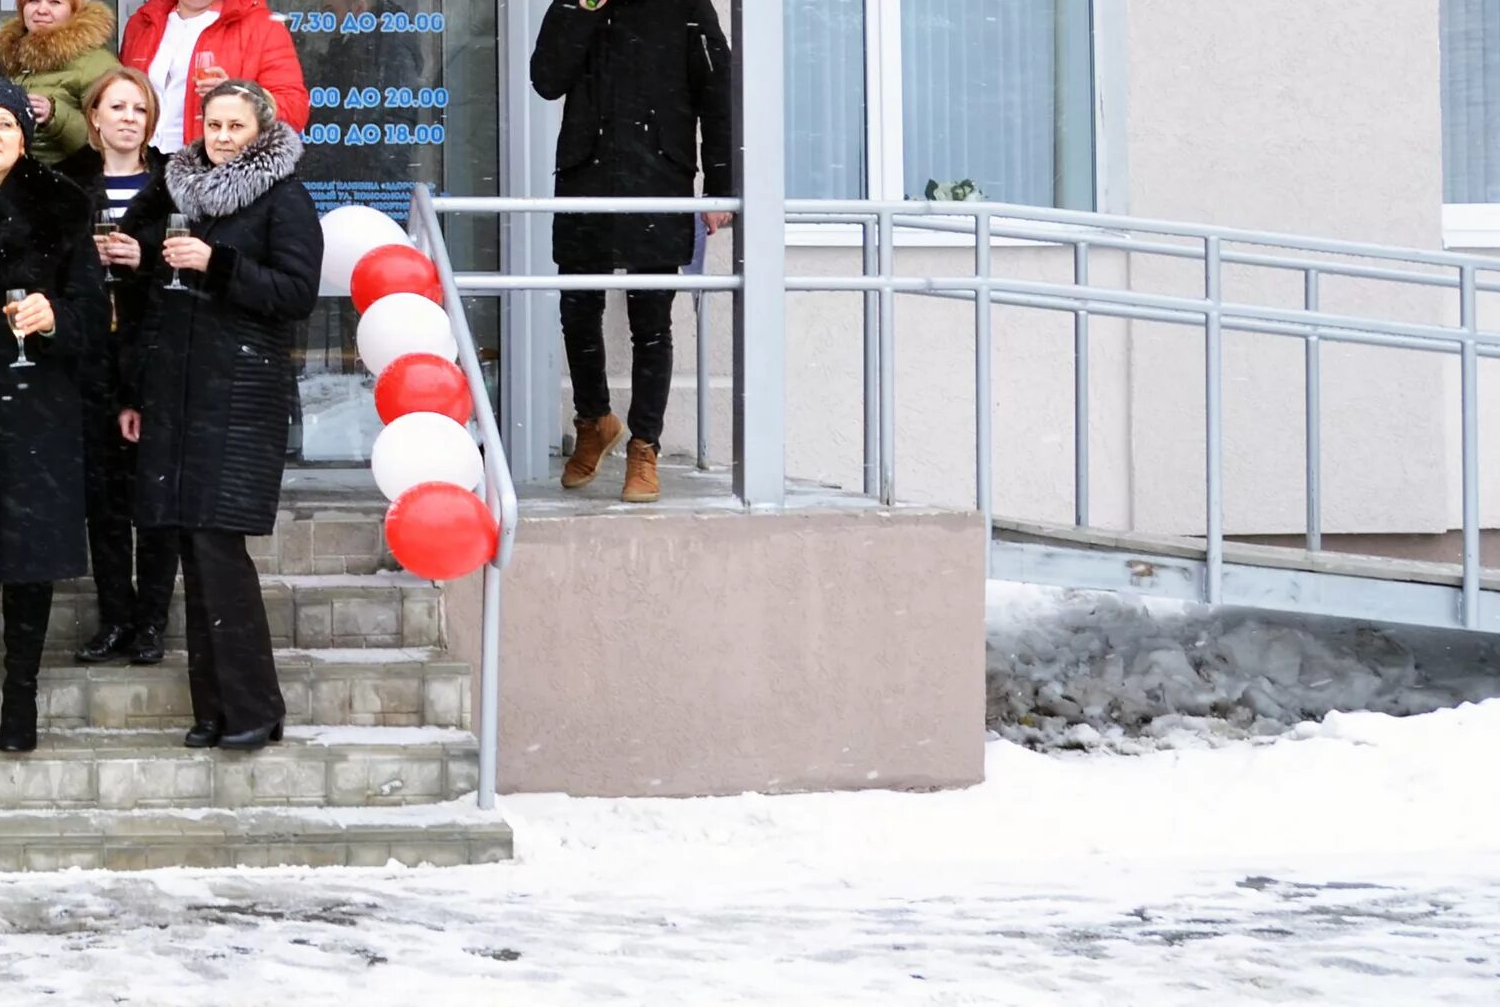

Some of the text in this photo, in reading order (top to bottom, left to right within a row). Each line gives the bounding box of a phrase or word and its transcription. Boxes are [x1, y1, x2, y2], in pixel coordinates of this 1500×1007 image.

[340, 12, 377, 34] ДО
[381, 12, 445, 32] 20.00
[344, 87, 380, 109] ДО
[385, 87, 449, 108] 20.00
[344, 123, 380, 145] ДО
[385, 123, 445, 145] 18.00
